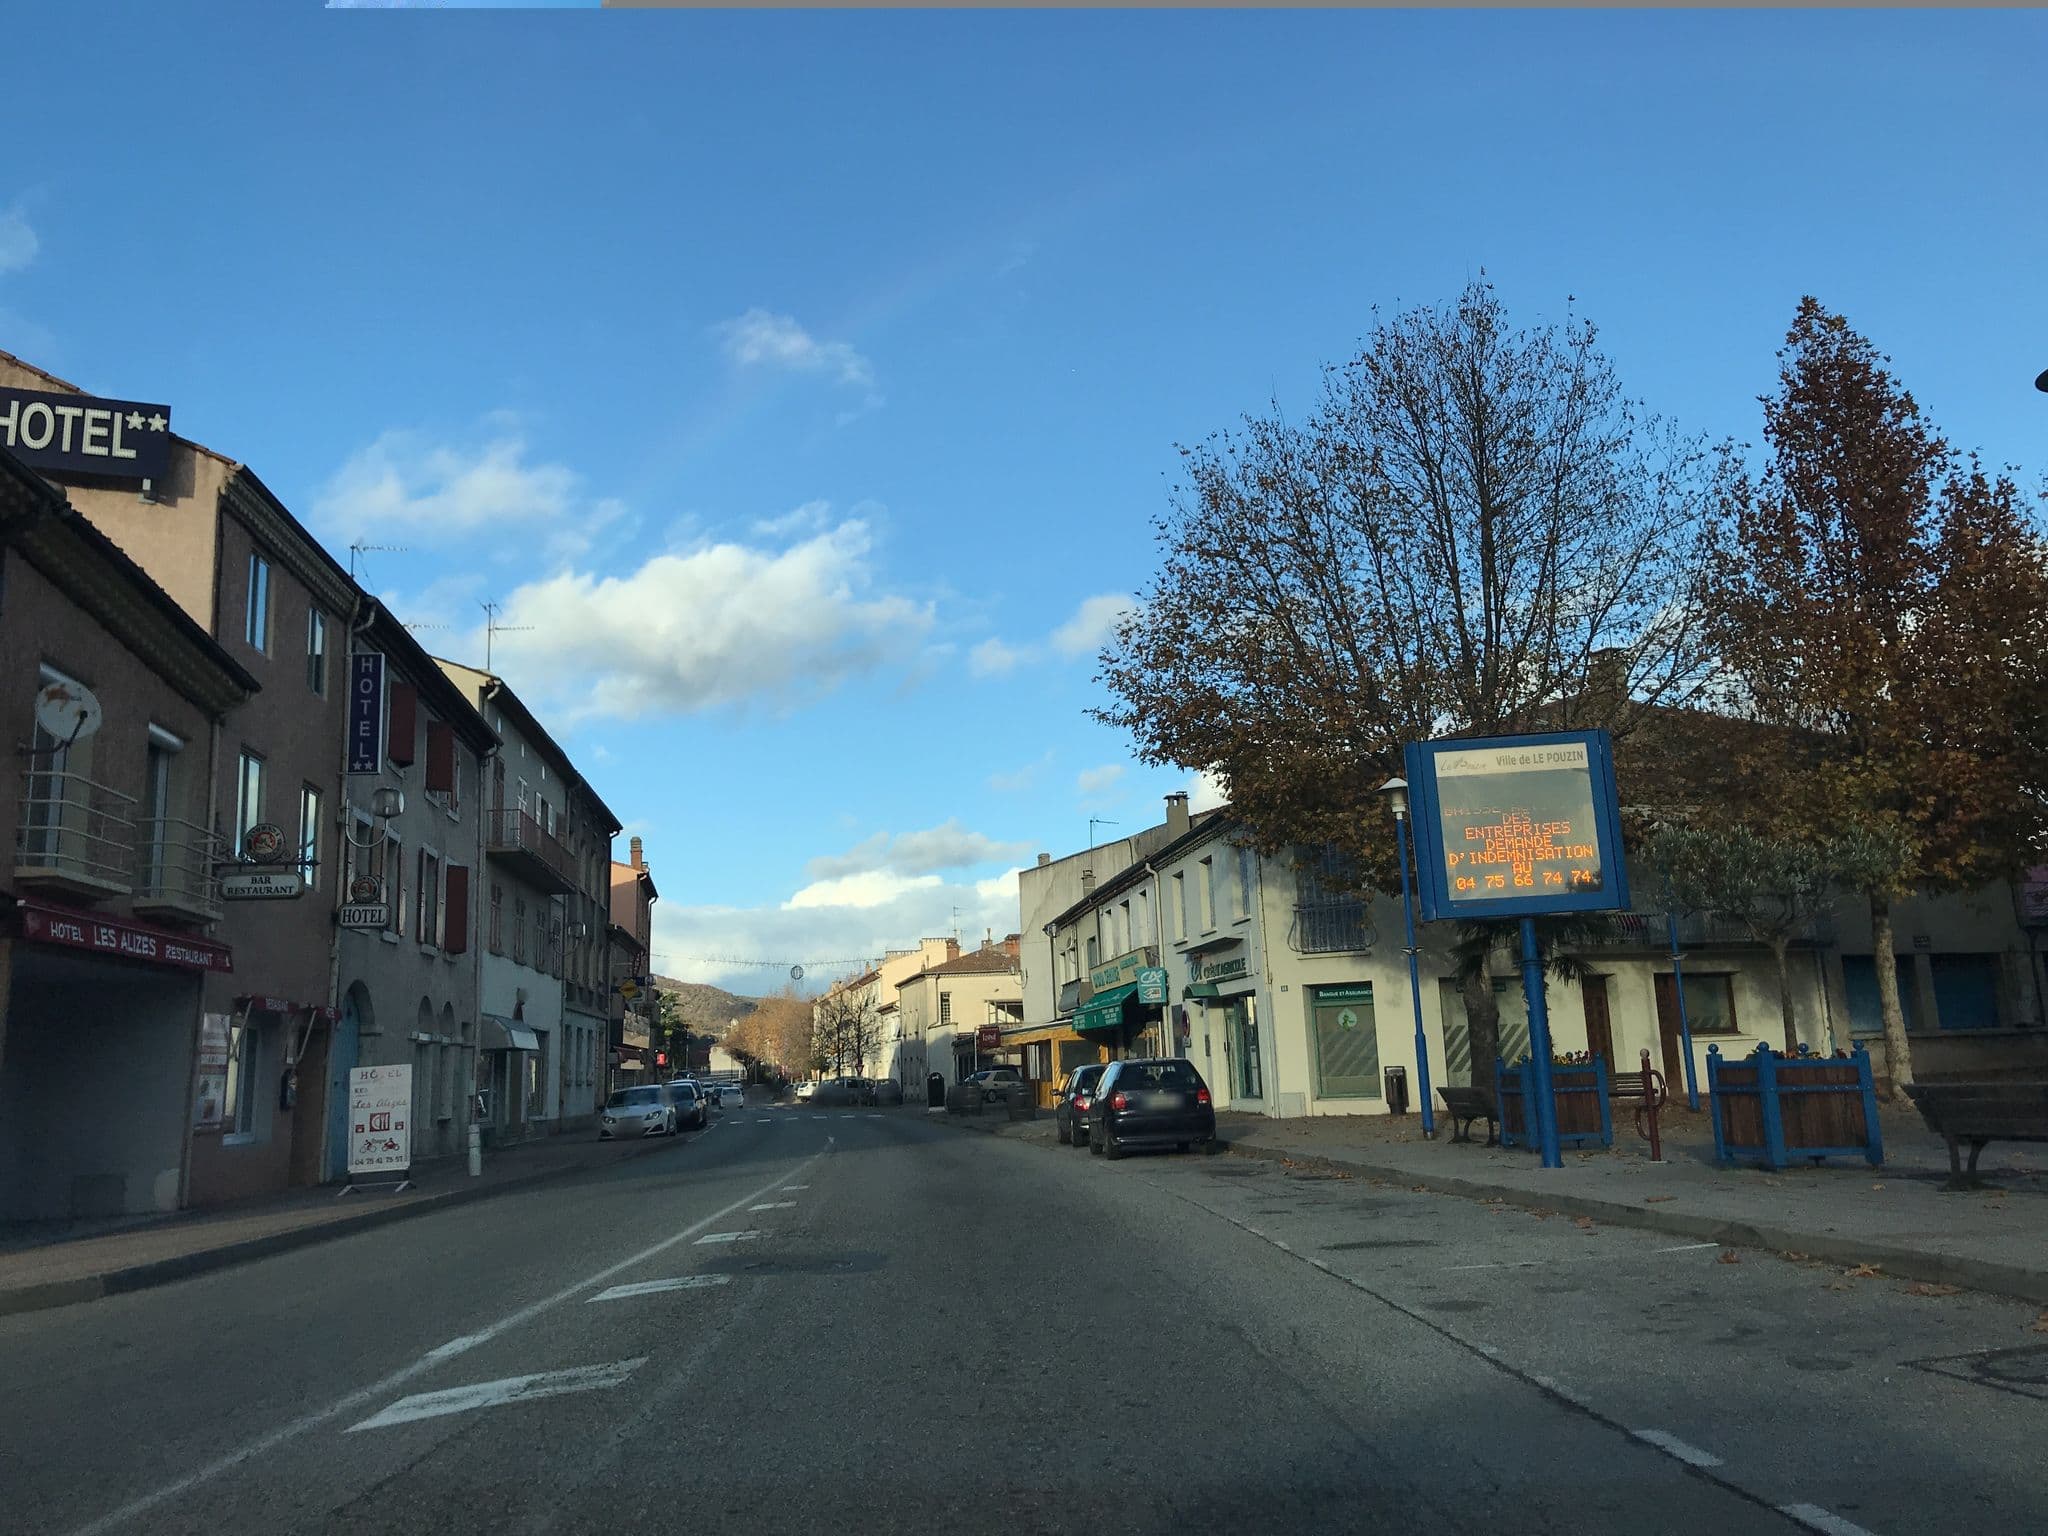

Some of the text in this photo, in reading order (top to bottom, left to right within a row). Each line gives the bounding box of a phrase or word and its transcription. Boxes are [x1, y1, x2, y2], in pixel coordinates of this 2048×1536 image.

[0, 400, 137, 459] HOTEL
[359, 656, 374, 758] HOTEL
[1496, 750, 1584, 767] Ville de LE POUZIN
[1502, 814, 1531, 825] DES
[1465, 821, 1571, 840] ENTREPRISES
[1486, 836, 1553, 850] DEMANDE
[1511, 862, 1533, 874] AU
[251, 876, 271, 884] BAR
[1456, 870, 1592, 890] 04 75 66 74 74
[227, 886, 293, 895] RESTAURANT
[342, 909, 386, 924] HOTEL
[51, 921, 84, 942] HOTEL
[94, 925, 116, 949] LES
[165, 944, 213, 967] RESTAURANT
